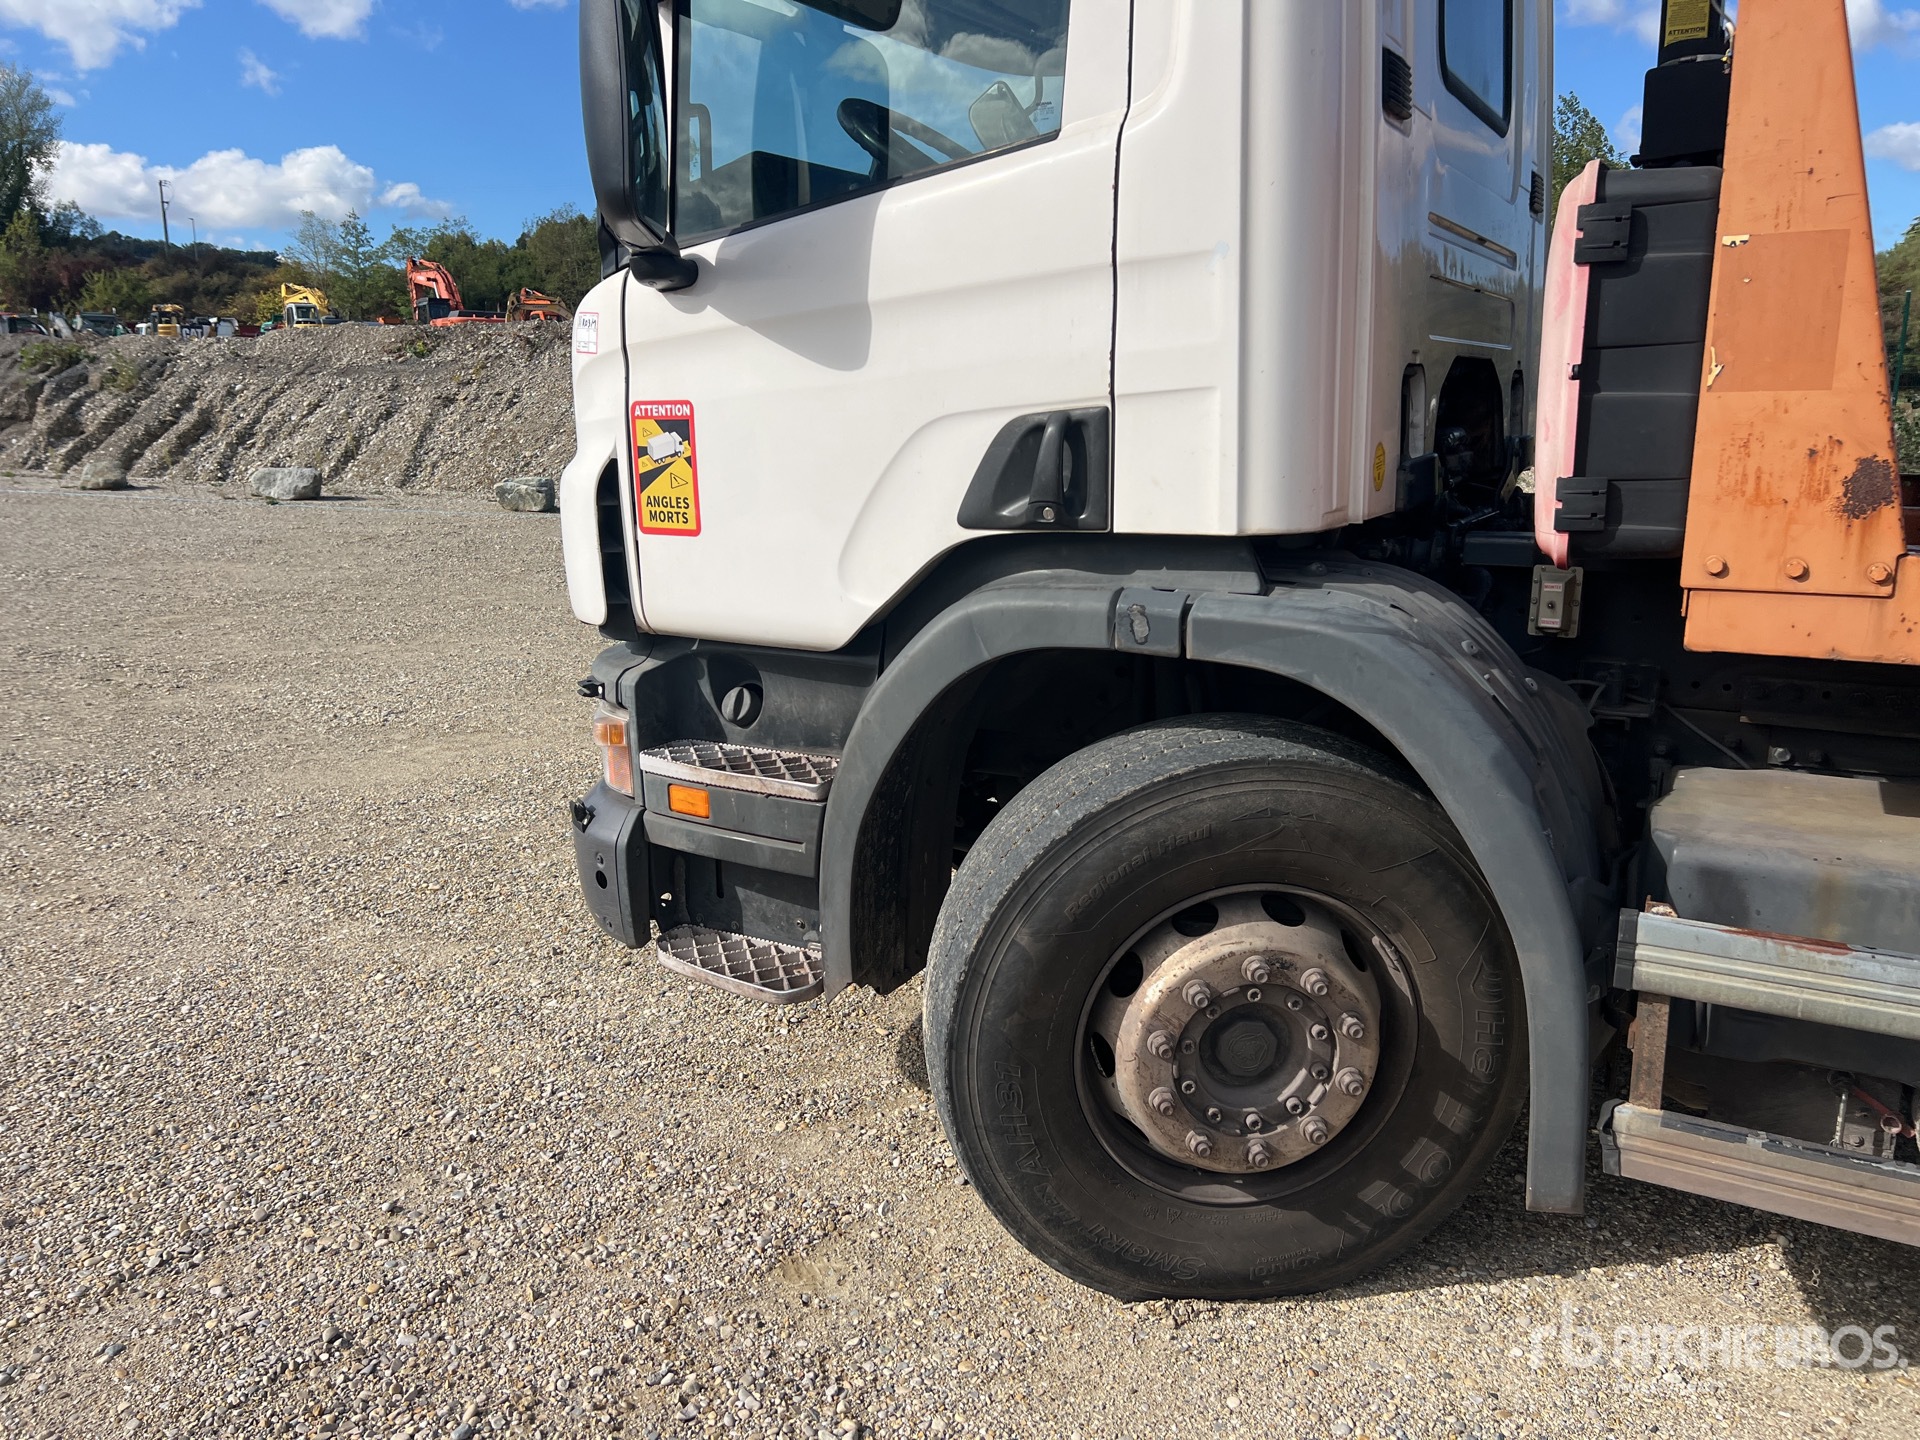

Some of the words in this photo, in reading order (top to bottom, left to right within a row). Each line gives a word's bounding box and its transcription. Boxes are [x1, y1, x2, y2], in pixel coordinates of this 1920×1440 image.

[1668, 26, 1705, 36] ATTENTION
[182, 327, 203, 339] CAT
[634, 404, 691, 417] ATTENTION
[646, 495, 690, 510] ANGLES
[649, 510, 689, 524] MORTS
[1063, 845, 1154, 923] Regional
[1157, 822, 1213, 856] Haul
[994, 1060, 1055, 1178] AH31
